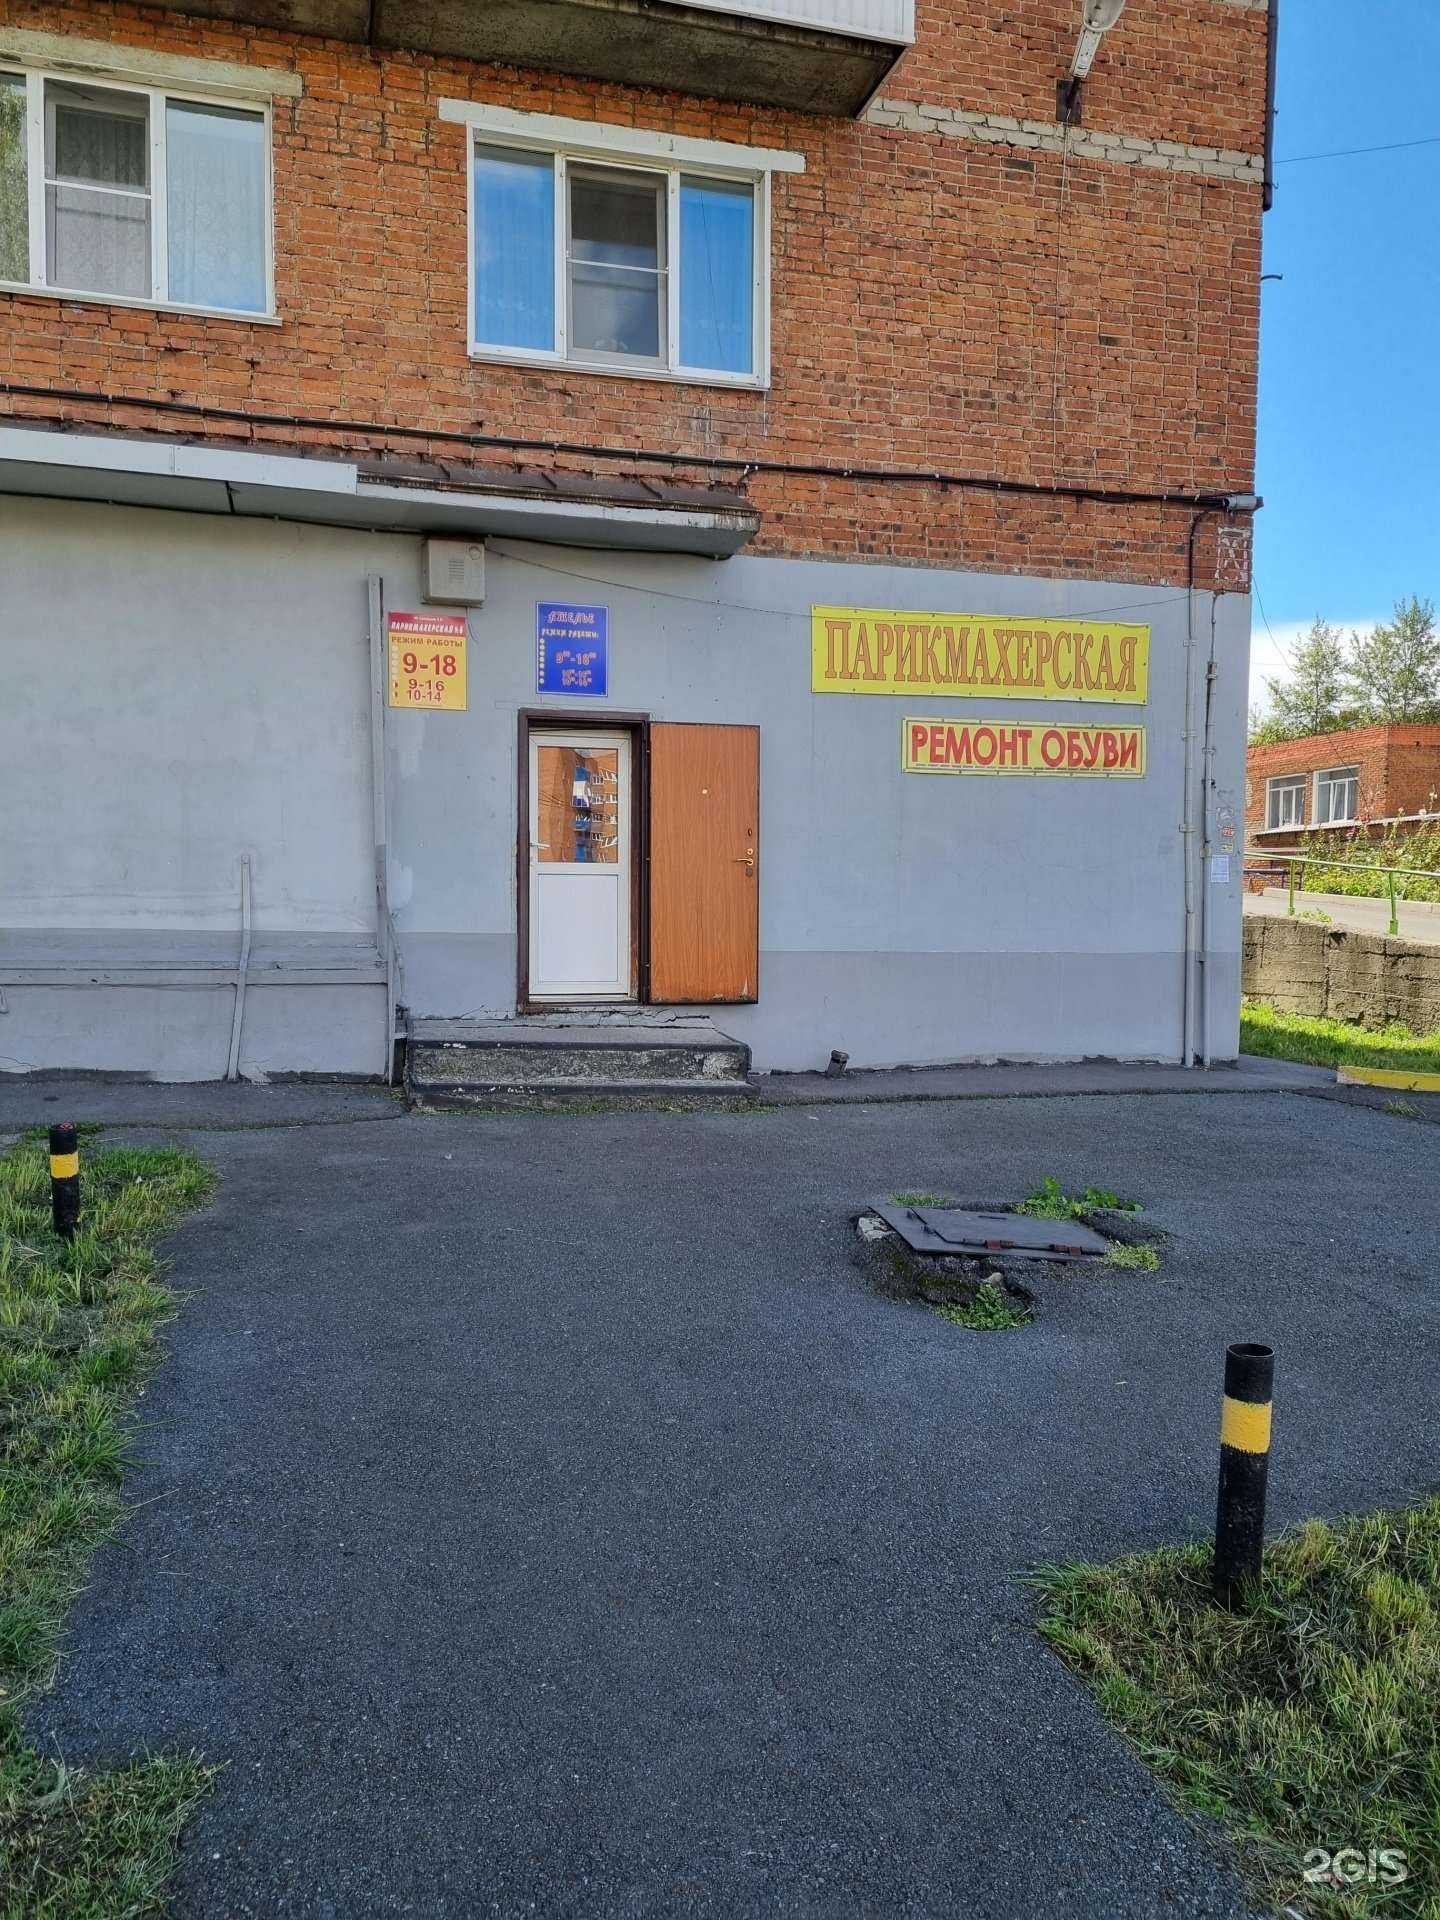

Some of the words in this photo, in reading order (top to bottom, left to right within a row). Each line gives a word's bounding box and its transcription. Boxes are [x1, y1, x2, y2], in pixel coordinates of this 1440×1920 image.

[391, 636, 424, 645] РЕЖИМ
[426, 638, 463, 648] РАБОТЫ
[402, 652, 457, 676] 9-18
[824, 620, 1138, 692] ПАРИКМАХЕРСКАЯ
[408, 678, 445, 692] 9-16
[406, 689, 442, 702] 10-14
[911, 724, 1033, 767] РЕМОНТ
[1040, 729, 1138, 769] ОБУВИ
